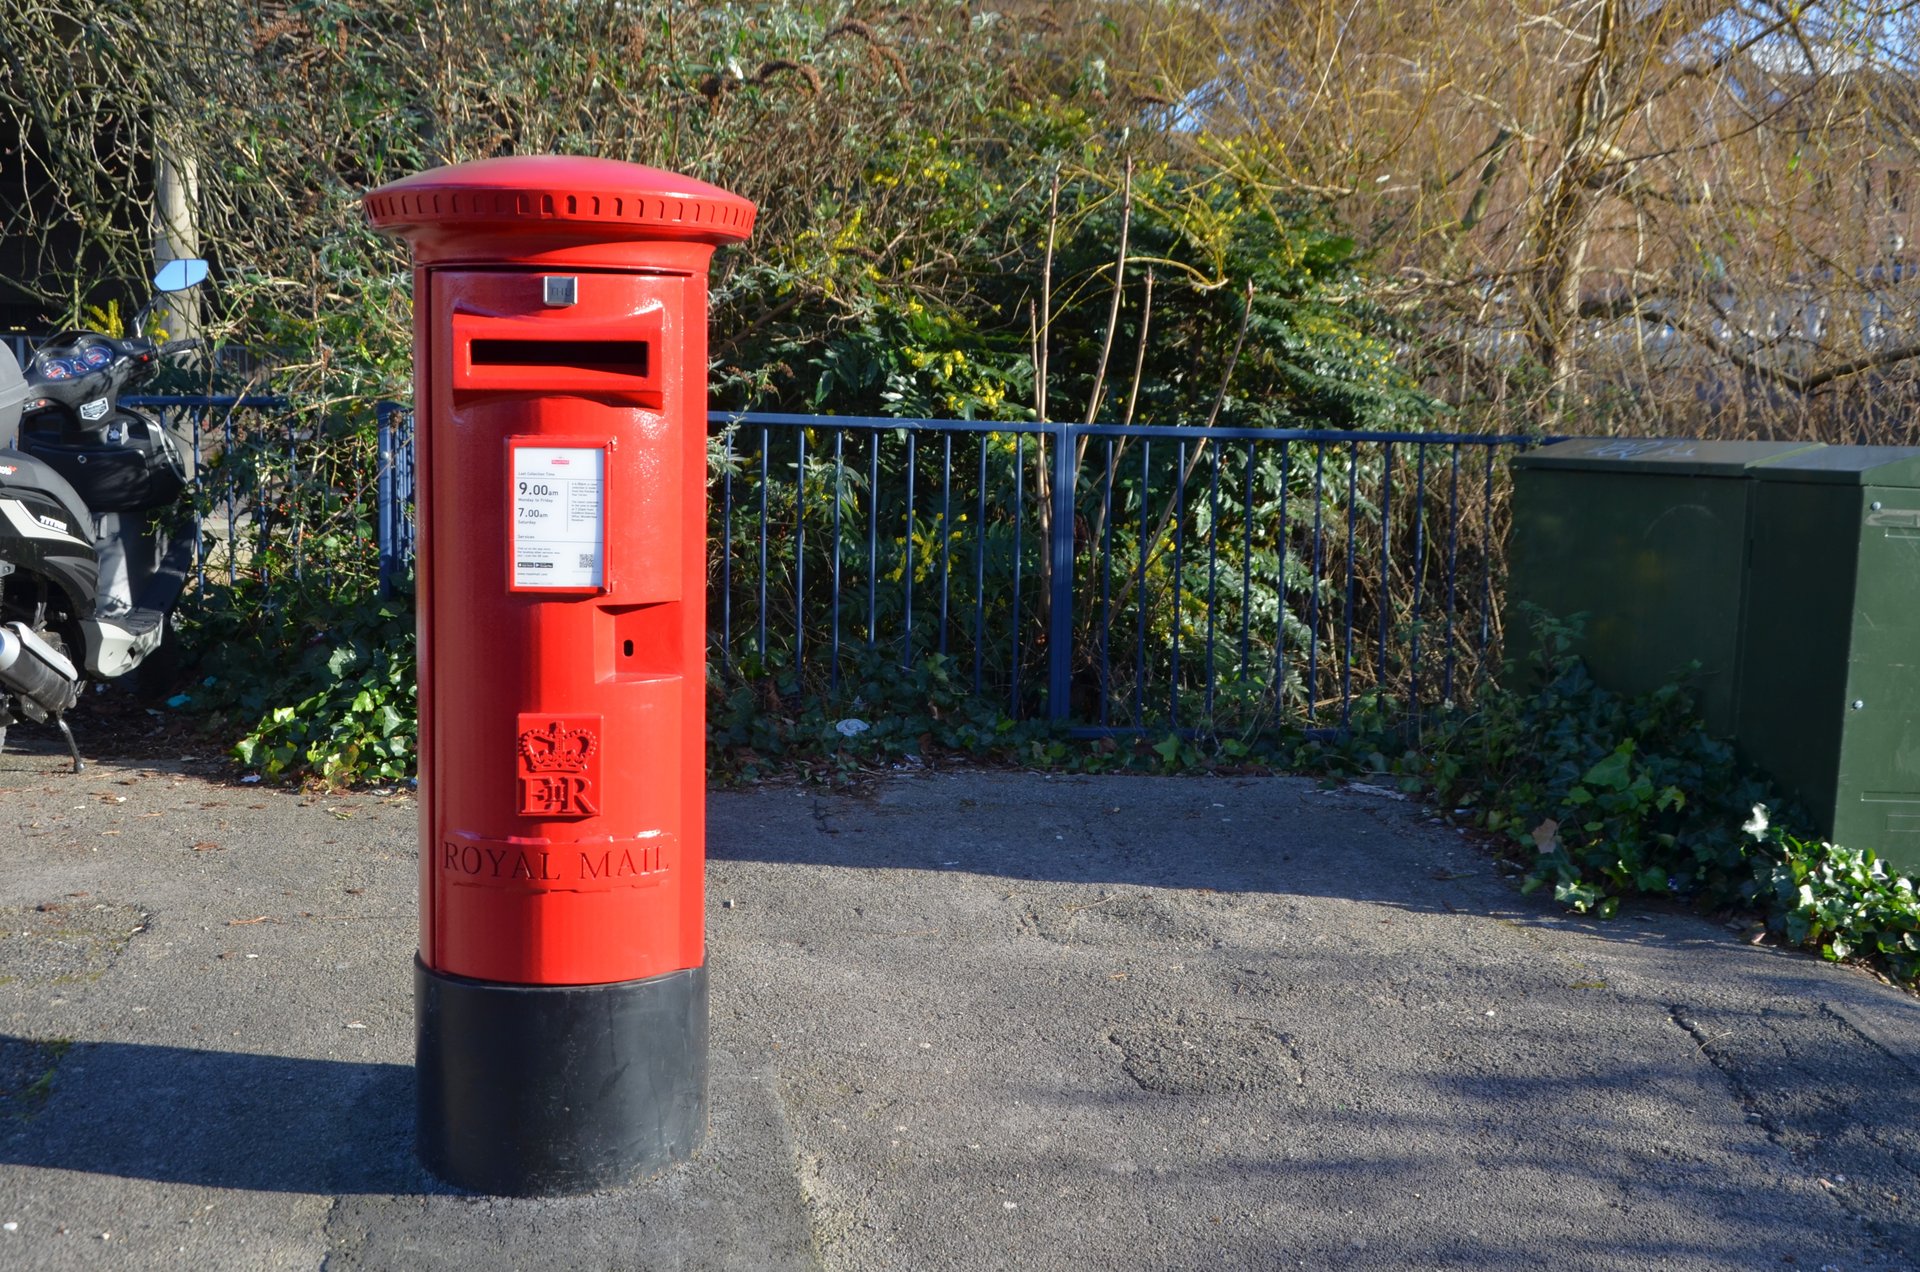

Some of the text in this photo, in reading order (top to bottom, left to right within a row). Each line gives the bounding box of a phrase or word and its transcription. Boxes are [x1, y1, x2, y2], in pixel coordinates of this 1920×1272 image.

[519, 482, 559, 496] 9.00am
[518, 508, 548, 518] 7.00am
[443, 842, 669, 880] ROYAL MAIL
